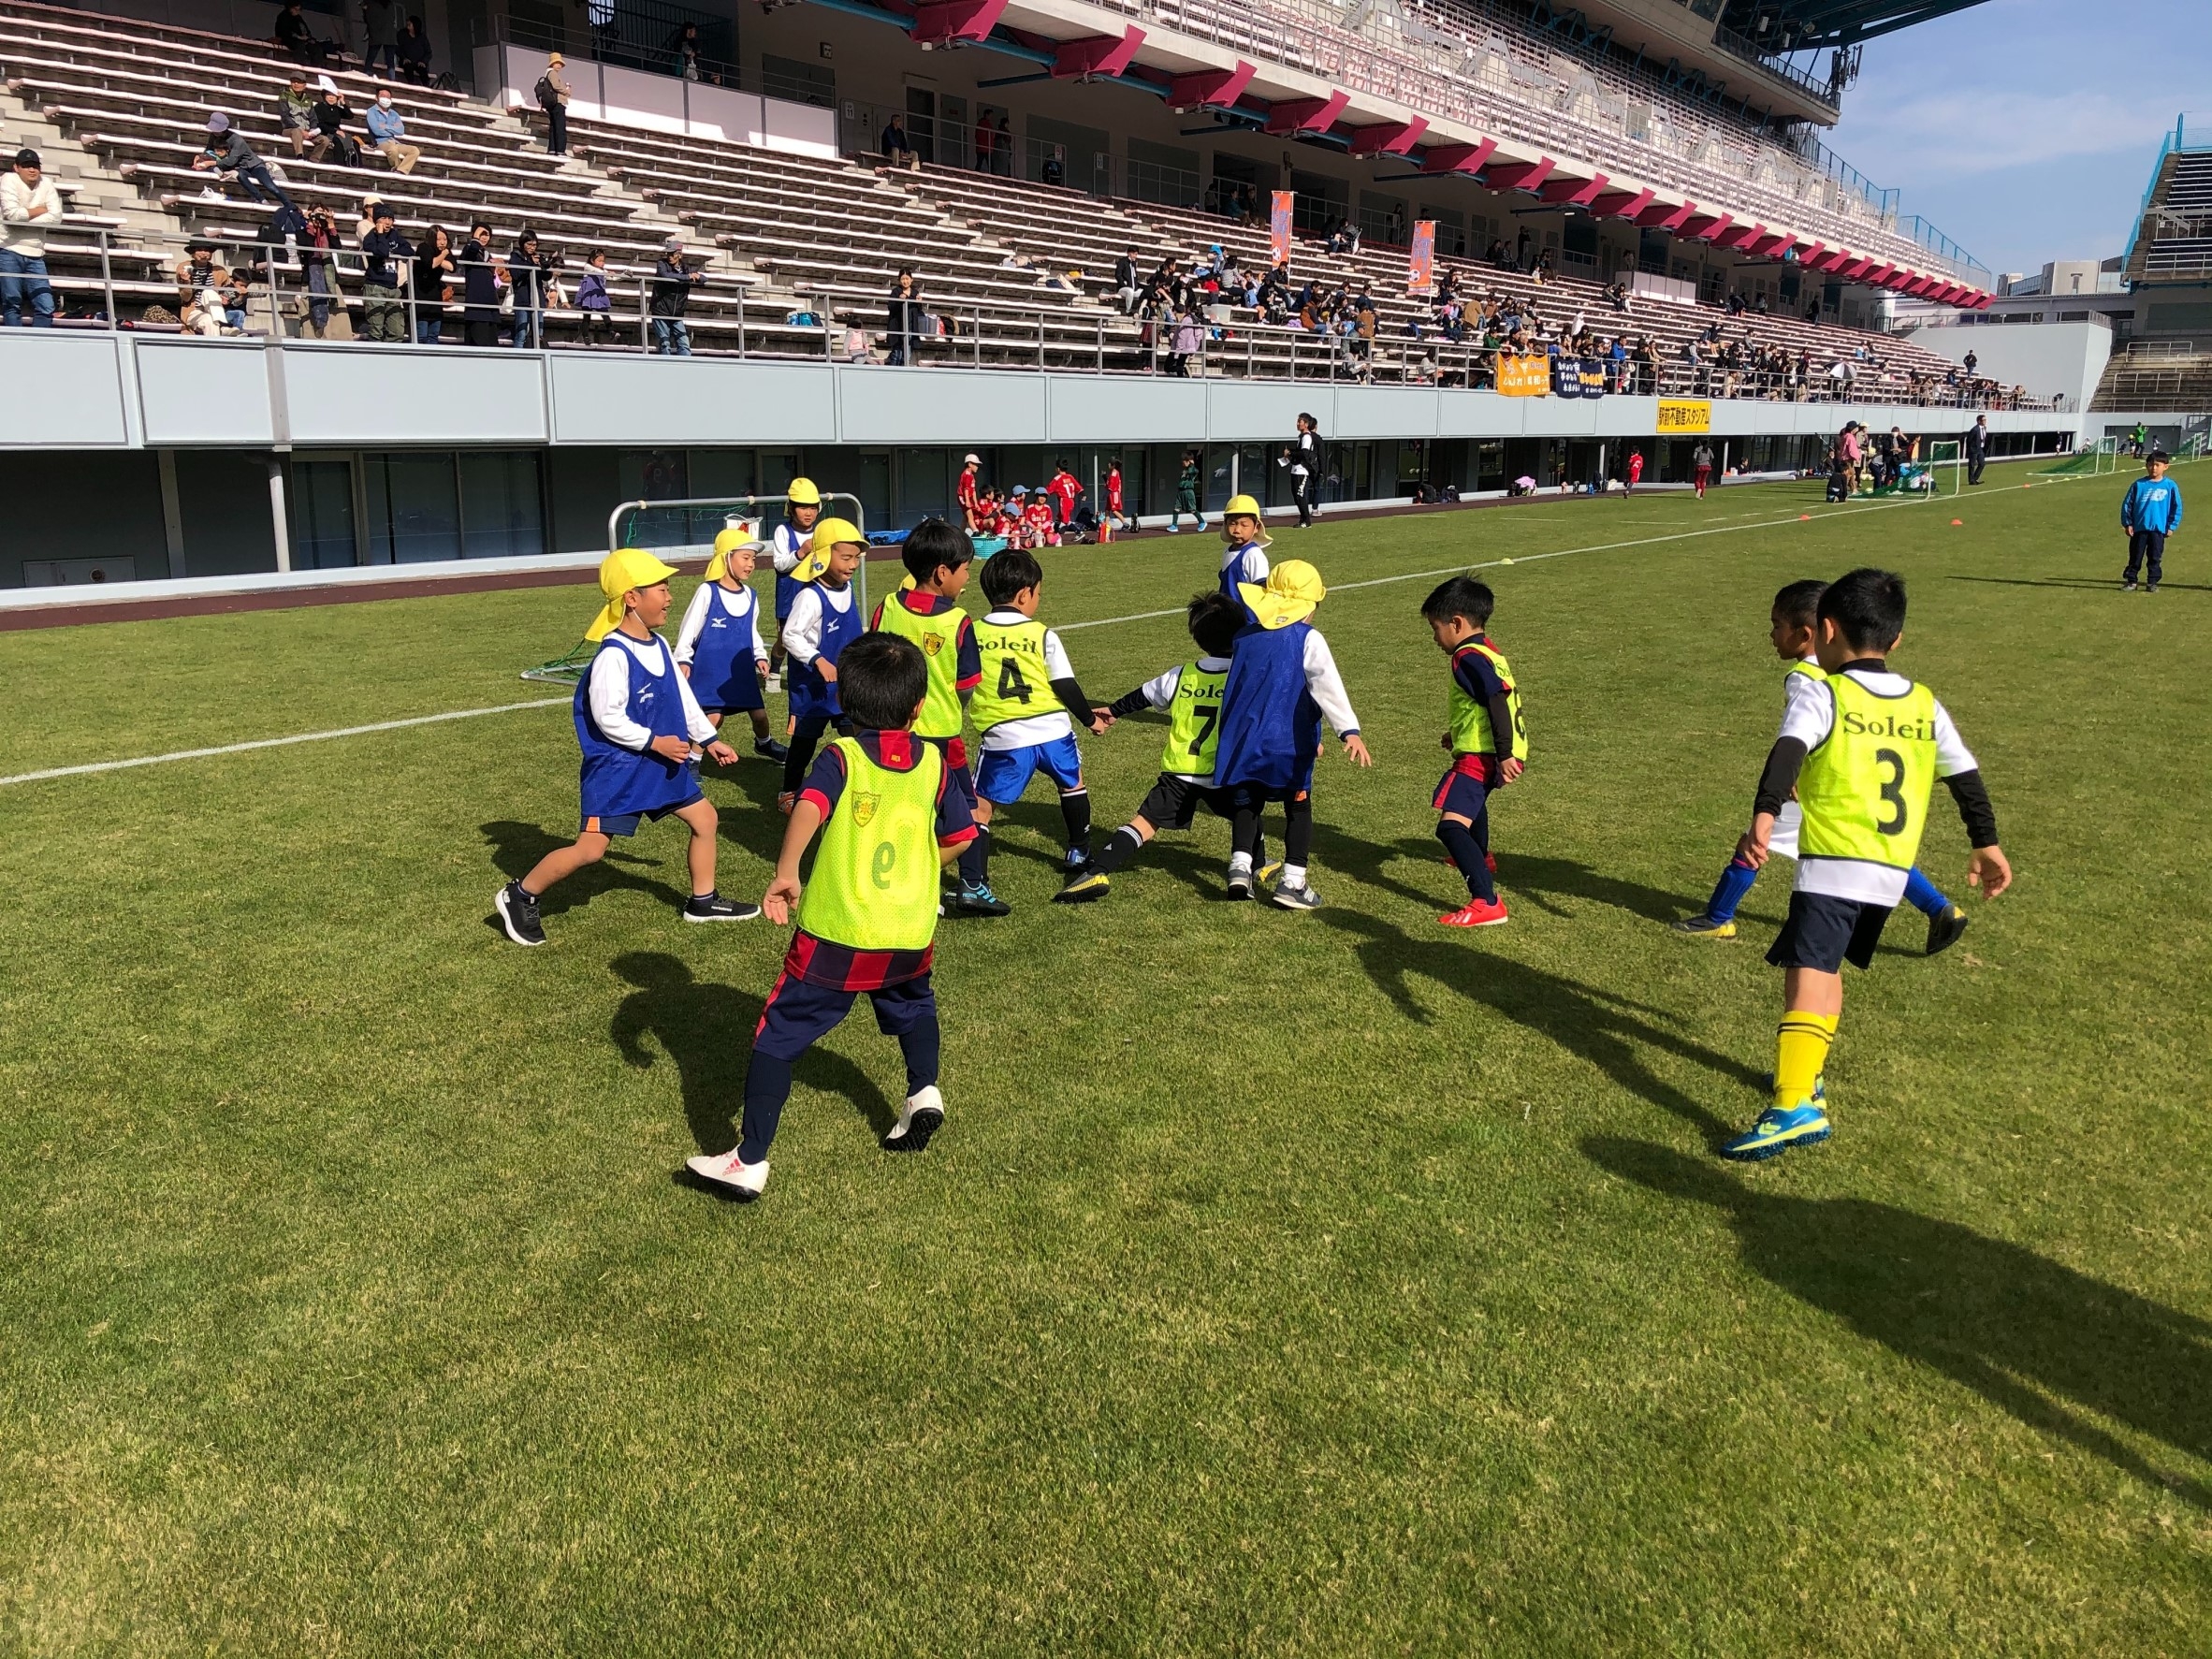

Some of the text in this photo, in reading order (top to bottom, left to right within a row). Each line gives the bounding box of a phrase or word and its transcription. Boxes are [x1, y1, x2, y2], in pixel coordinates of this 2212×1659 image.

[1658, 406, 1710, 427] 駅前不動産スタジアム
[997, 657, 1033, 705] 4
[1179, 683, 1224, 699] Sole
[1187, 705, 1218, 756] 7
[1843, 711, 1937, 742] Soleil
[1875, 749, 1908, 836] 3
[721, 1167, 746, 1176] adidas
